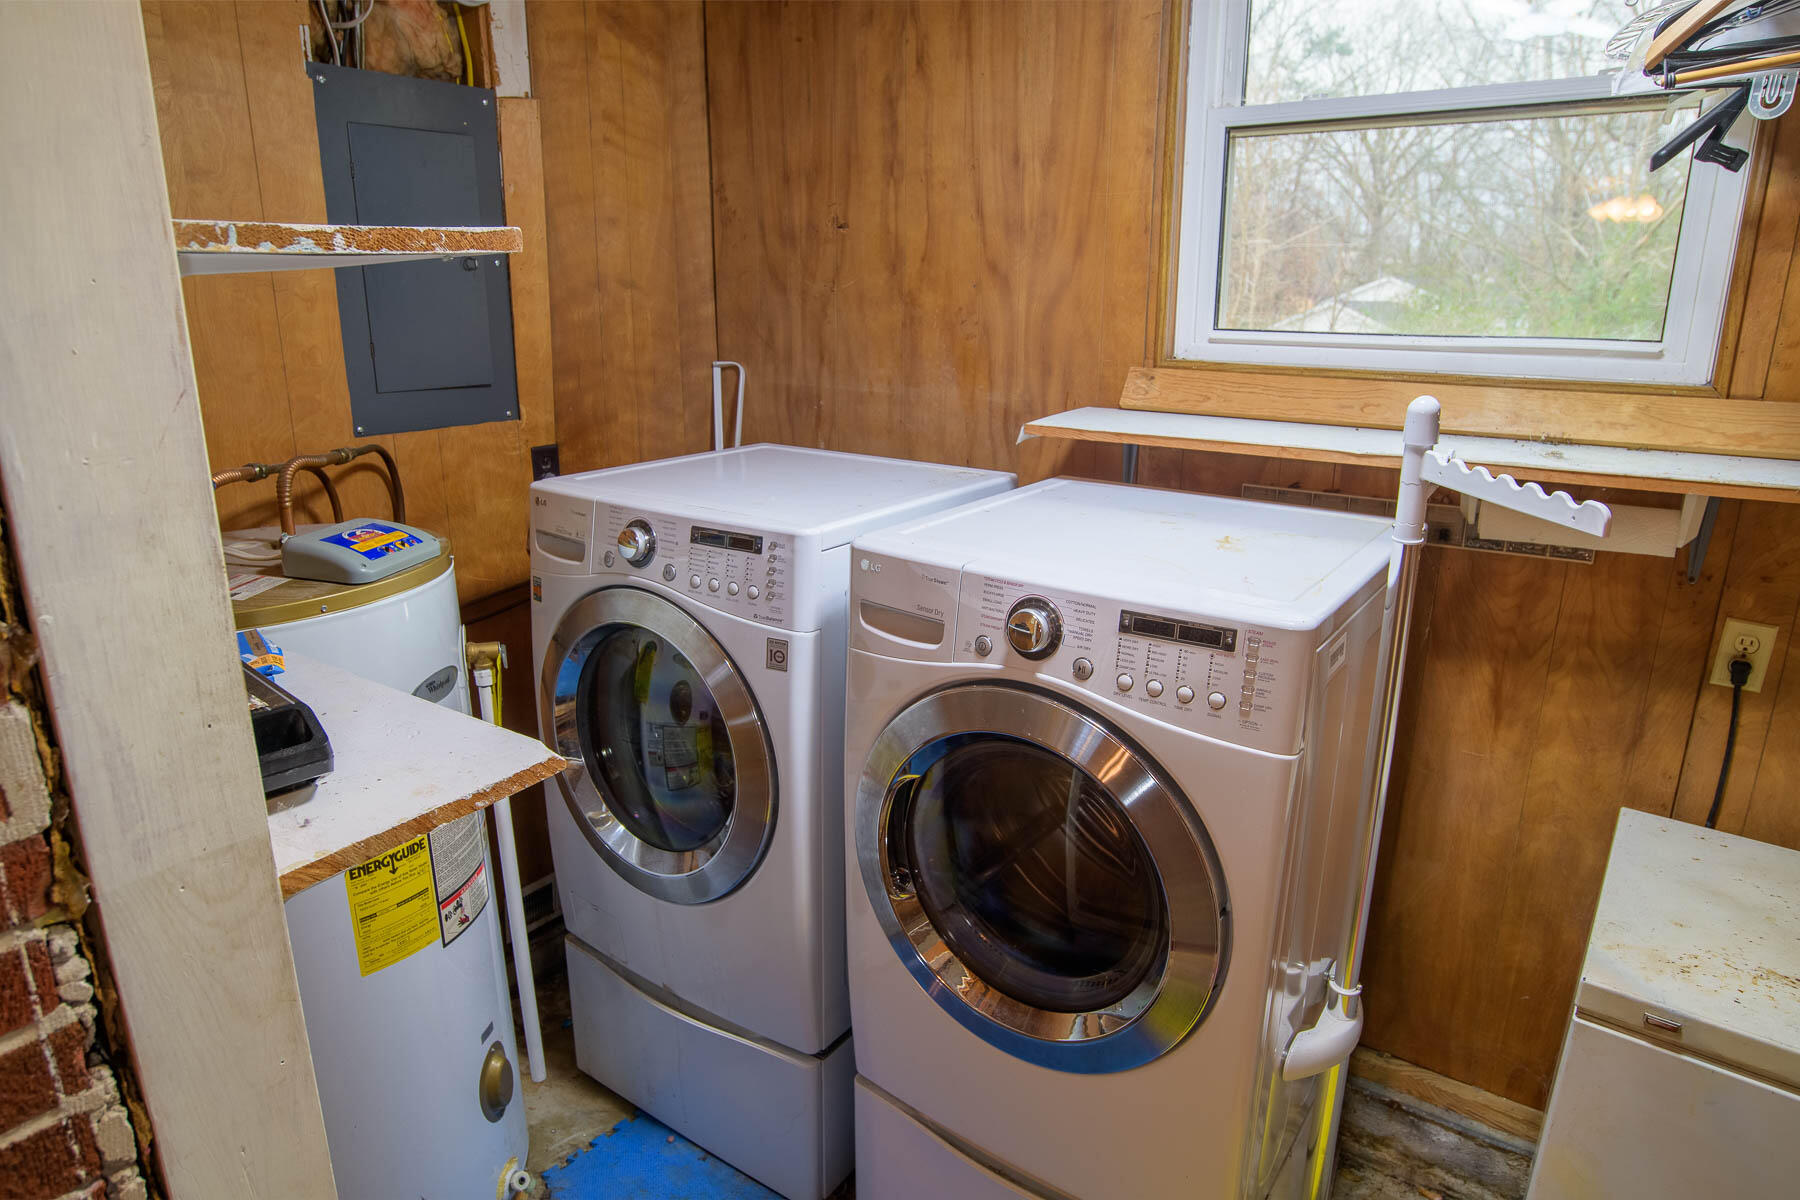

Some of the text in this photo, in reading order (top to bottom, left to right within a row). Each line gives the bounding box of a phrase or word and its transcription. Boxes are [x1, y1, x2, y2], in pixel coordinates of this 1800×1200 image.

[540, 498, 547, 506] LG
[870, 562, 881, 573] LG
[916, 604, 945, 618] Sensor Dry
[349, 837, 427, 881] ENERGYGUIDE
